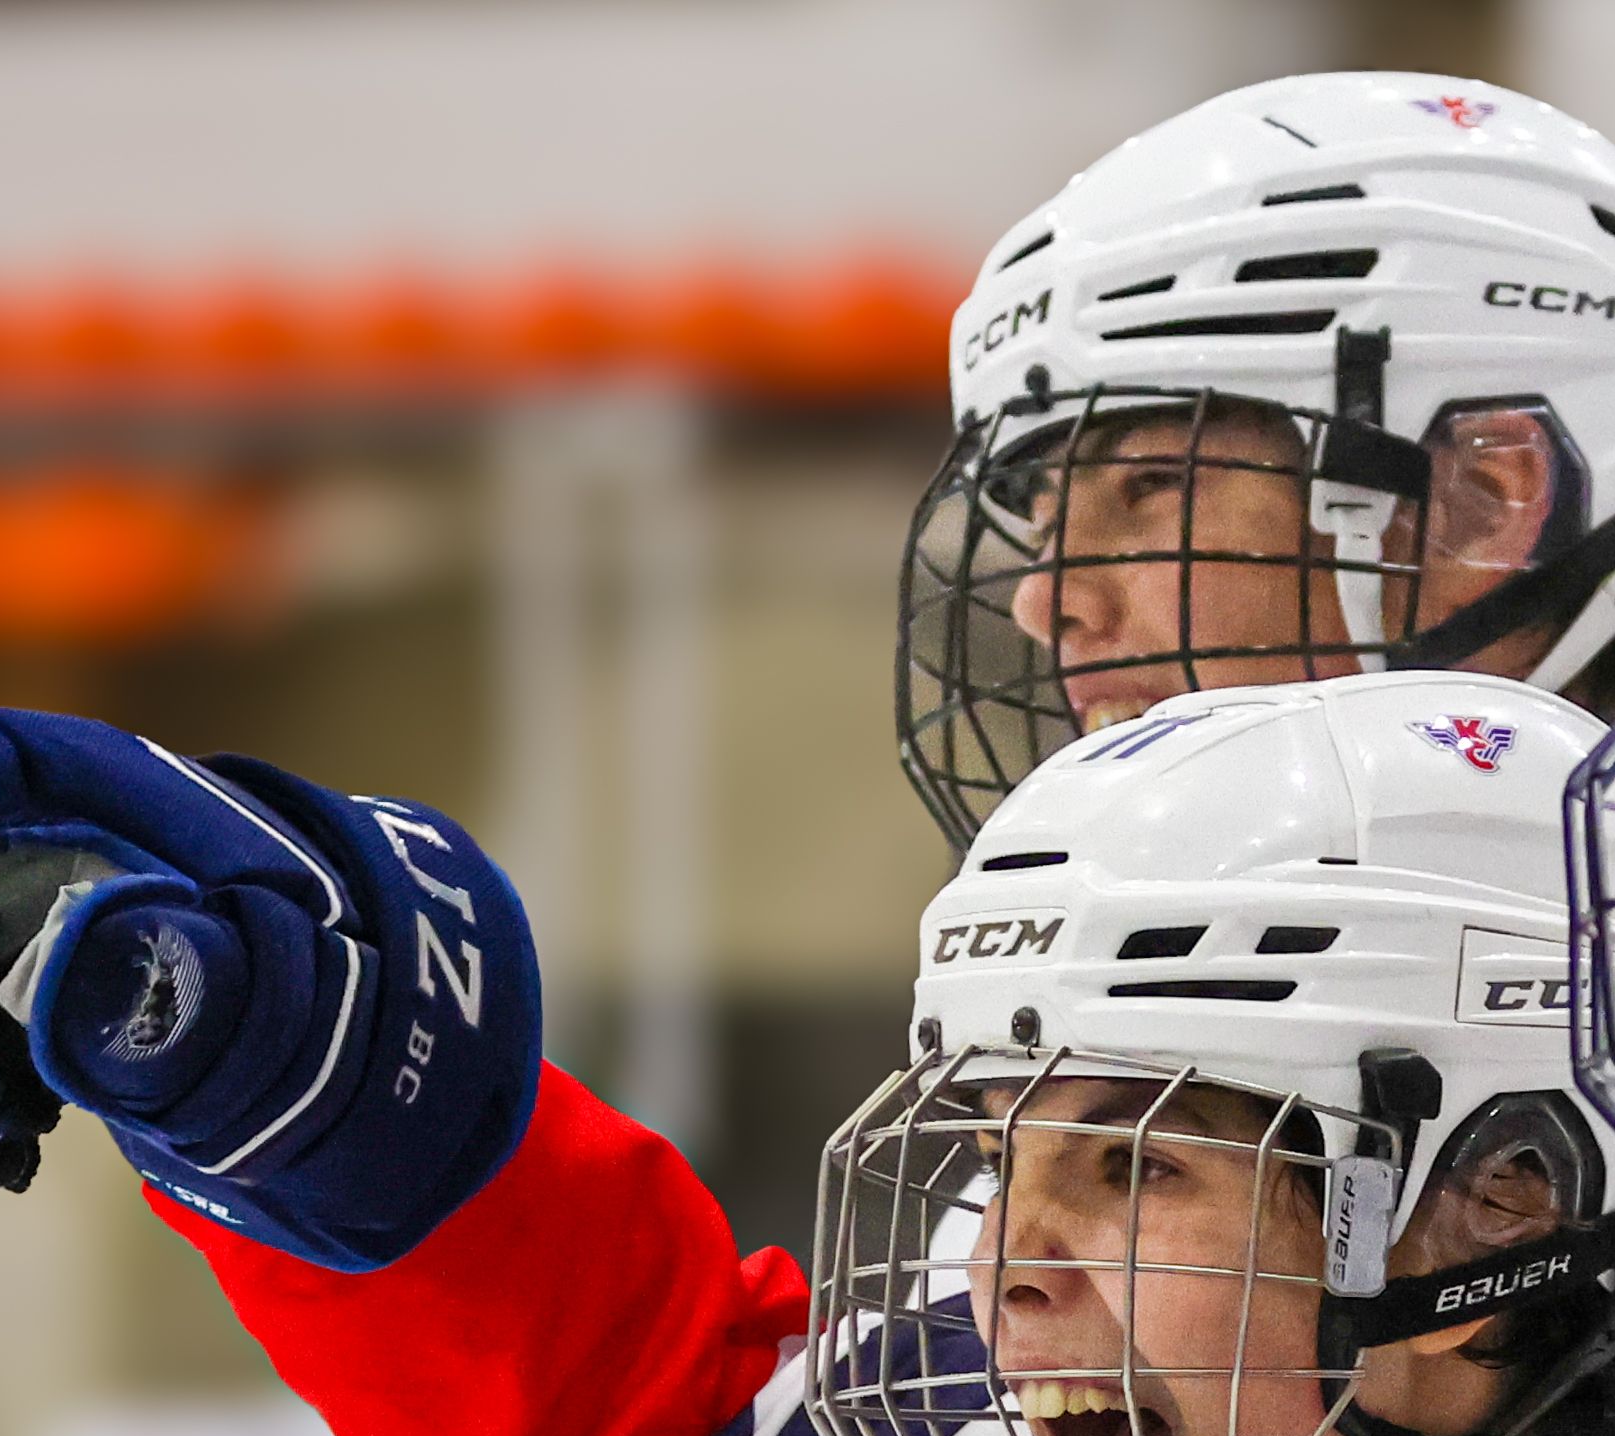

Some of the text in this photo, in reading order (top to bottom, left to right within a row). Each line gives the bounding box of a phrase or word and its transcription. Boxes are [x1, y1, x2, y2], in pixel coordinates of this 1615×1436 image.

[966, 288, 1053, 372] CCM
[348, 795, 482, 1104] UZ BC
[933, 918, 1066, 964] CCM
[1435, 1253, 1572, 1313] BAUER
